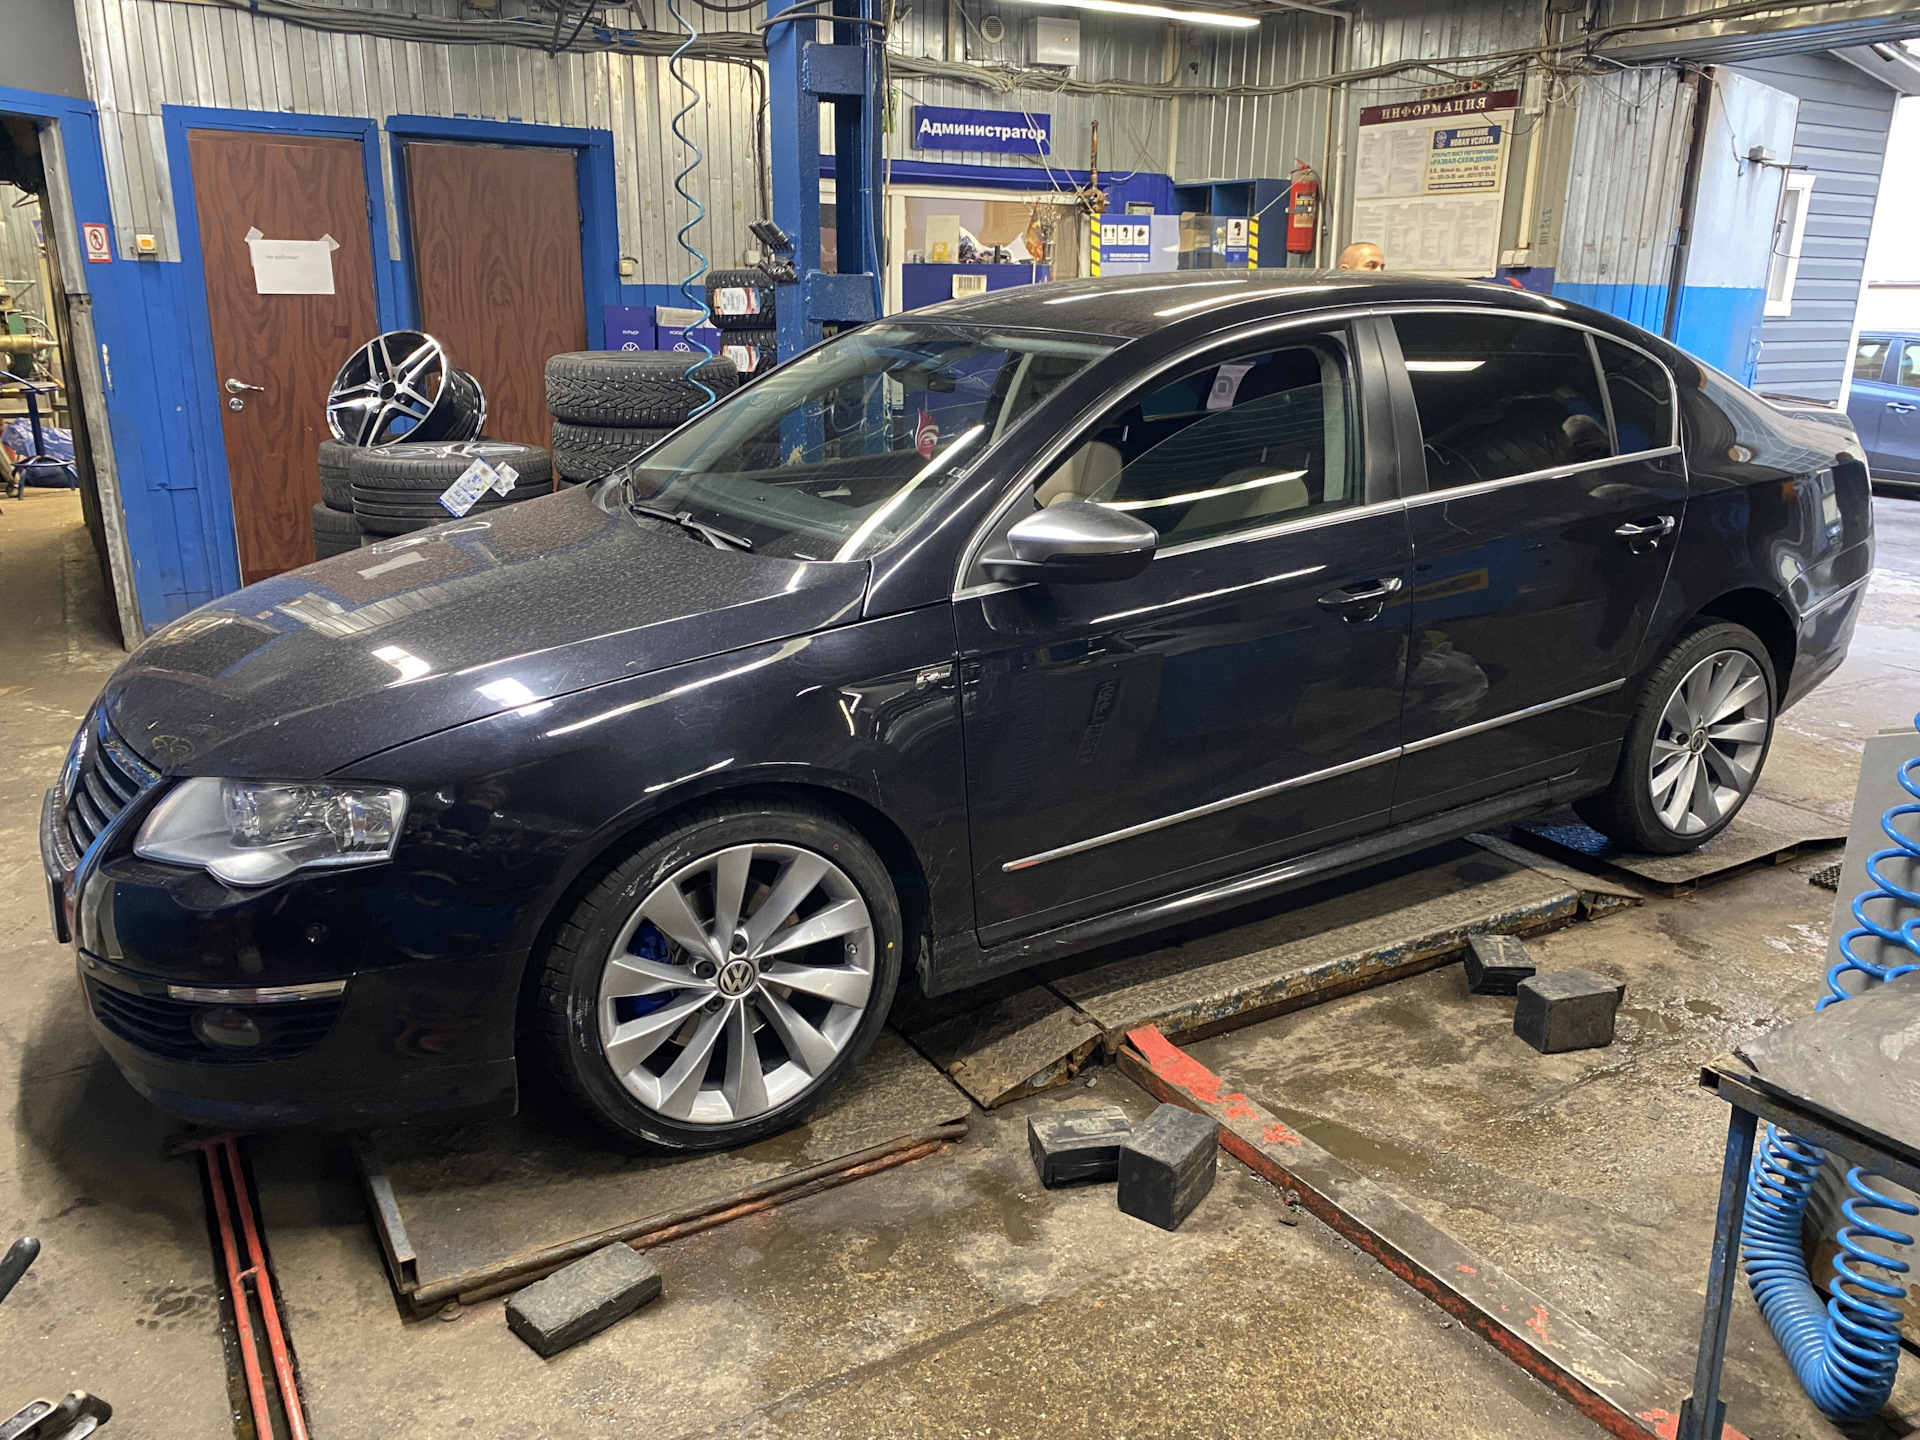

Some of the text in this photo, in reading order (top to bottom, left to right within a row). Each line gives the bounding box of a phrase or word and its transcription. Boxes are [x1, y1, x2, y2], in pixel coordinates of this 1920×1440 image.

[1381, 97, 1487, 120] ИНФОРМАЦИЯ
[919, 118, 1047, 143] Администратор
[1456, 128, 1490, 138] ВНИМАНИЕ
[1450, 138, 1470, 147] НОВАЯ
[1470, 136, 1494, 146] УСЛУГА
